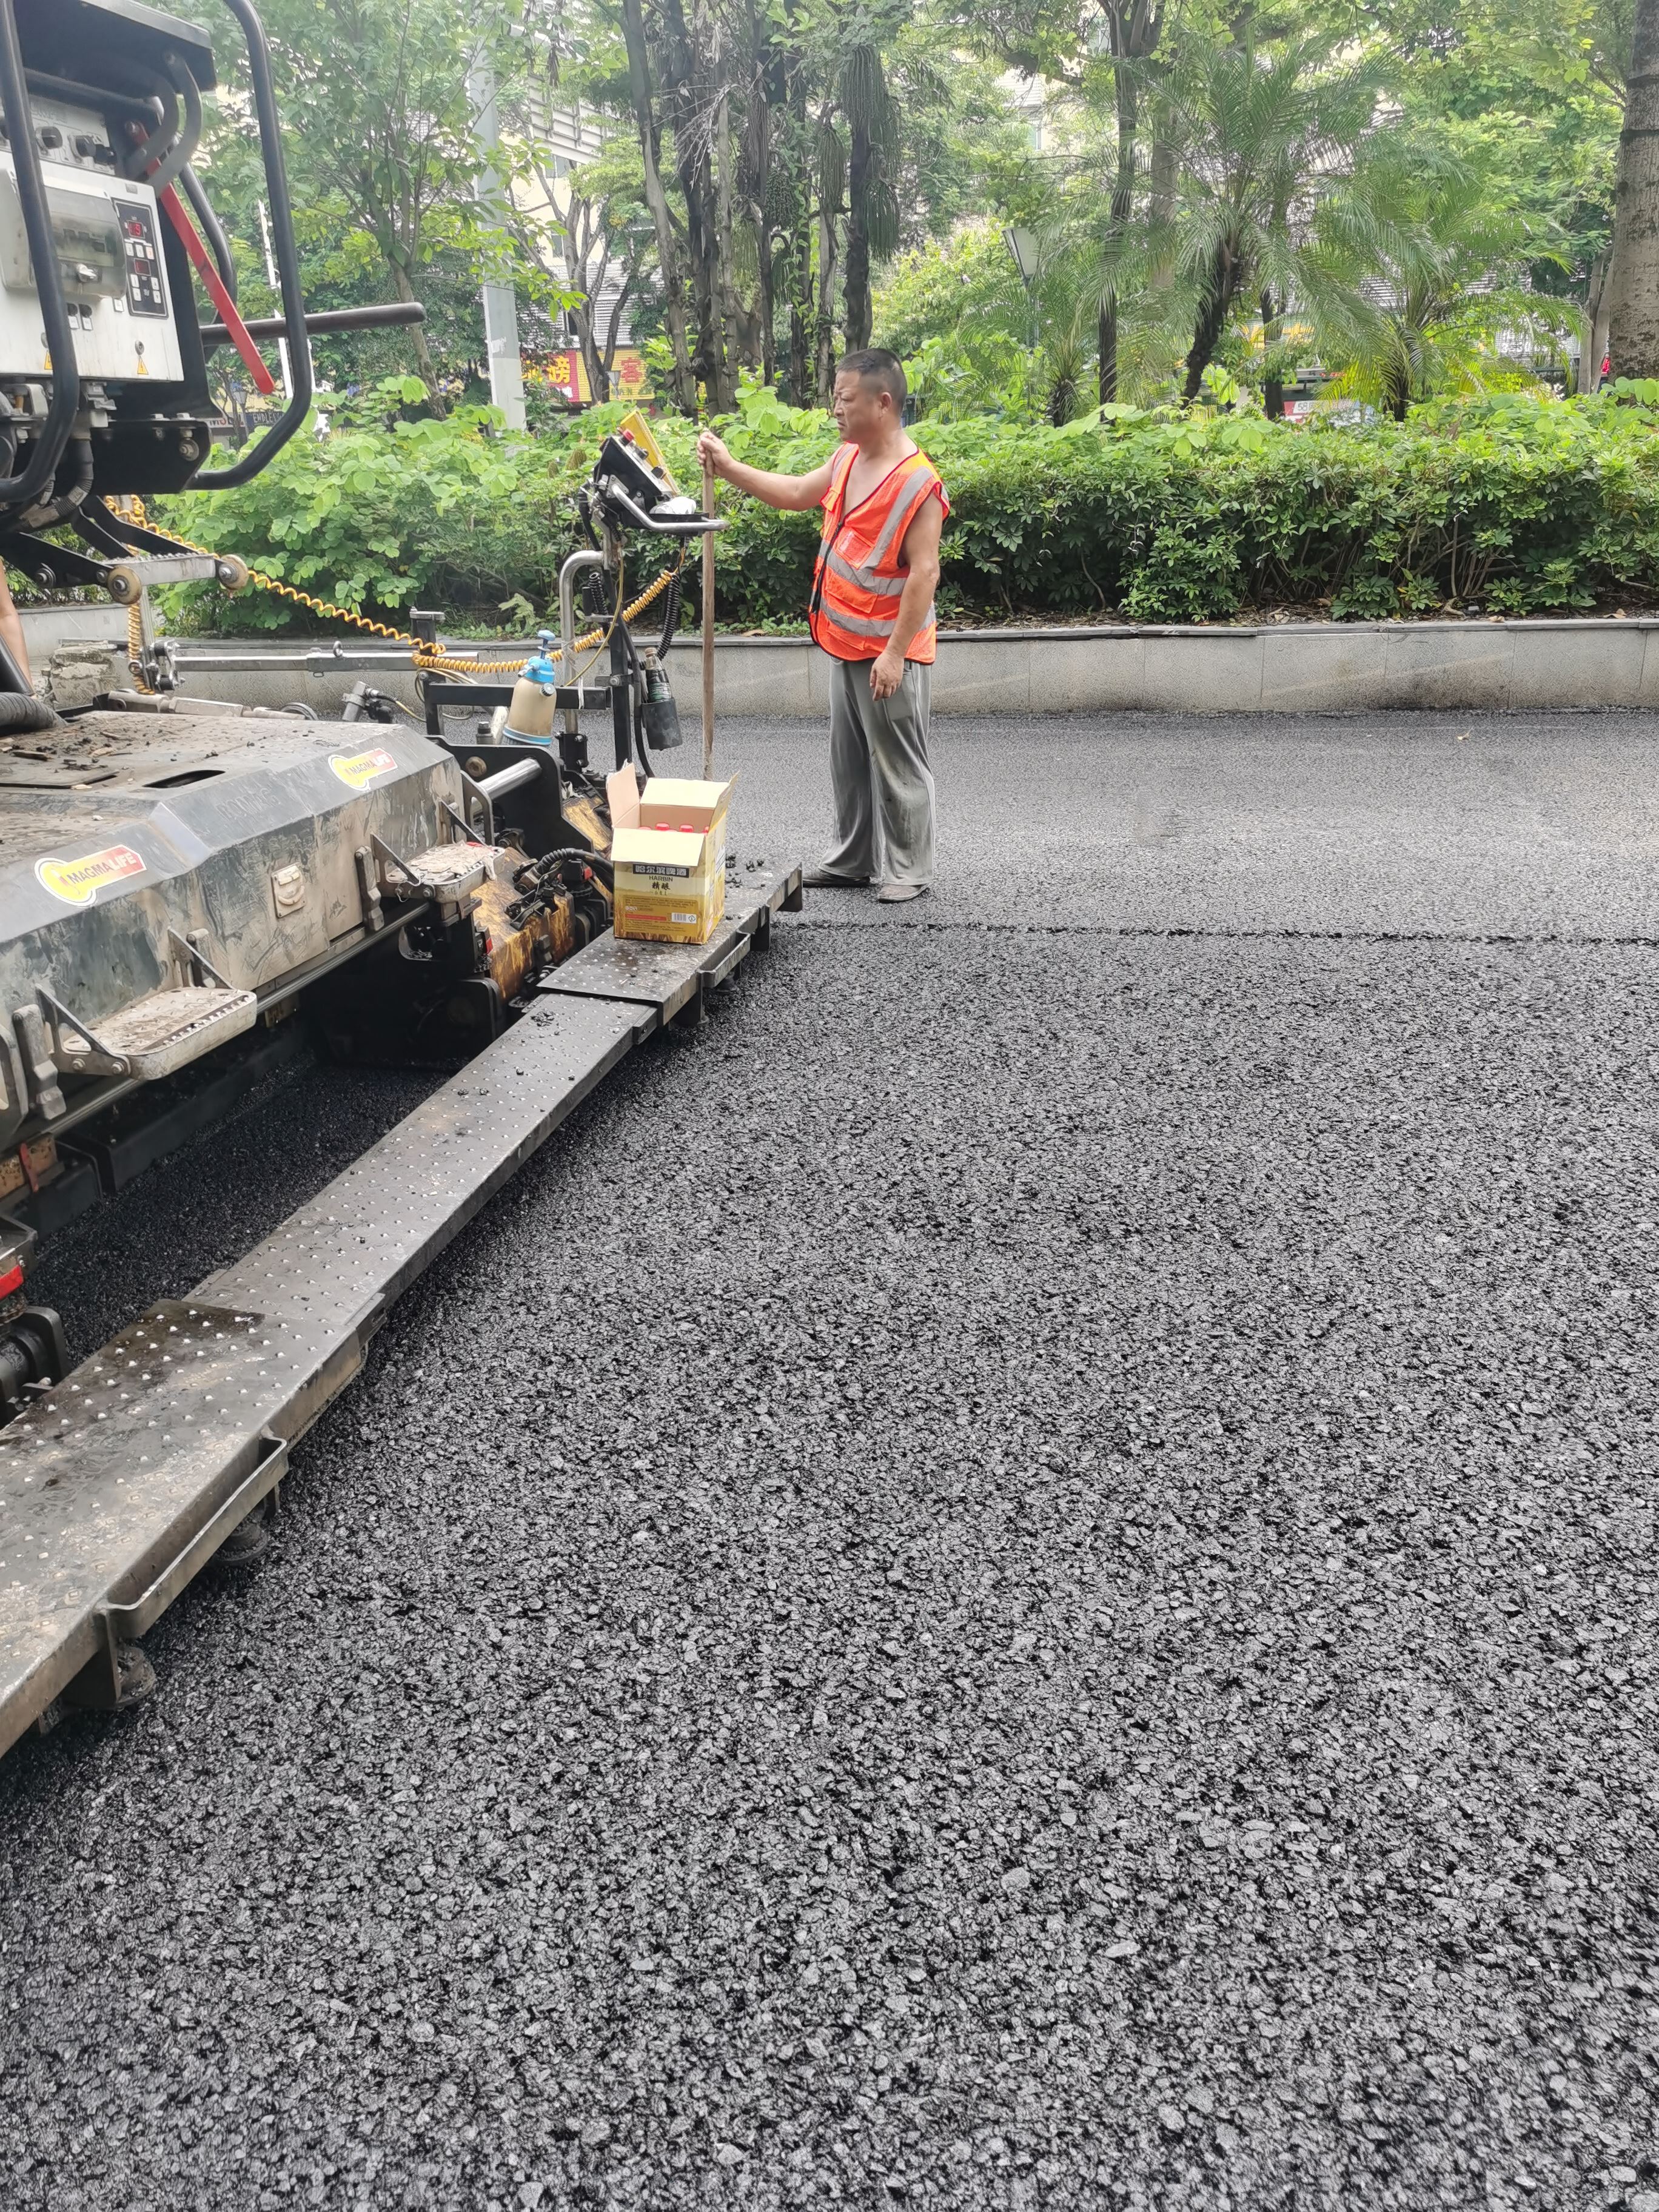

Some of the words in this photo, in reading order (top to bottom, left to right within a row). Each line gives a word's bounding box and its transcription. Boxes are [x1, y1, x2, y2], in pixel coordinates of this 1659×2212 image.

[66, 851, 138, 885] MAGMALIFE
[635, 865, 687, 876] 哈尔滨啤酒
